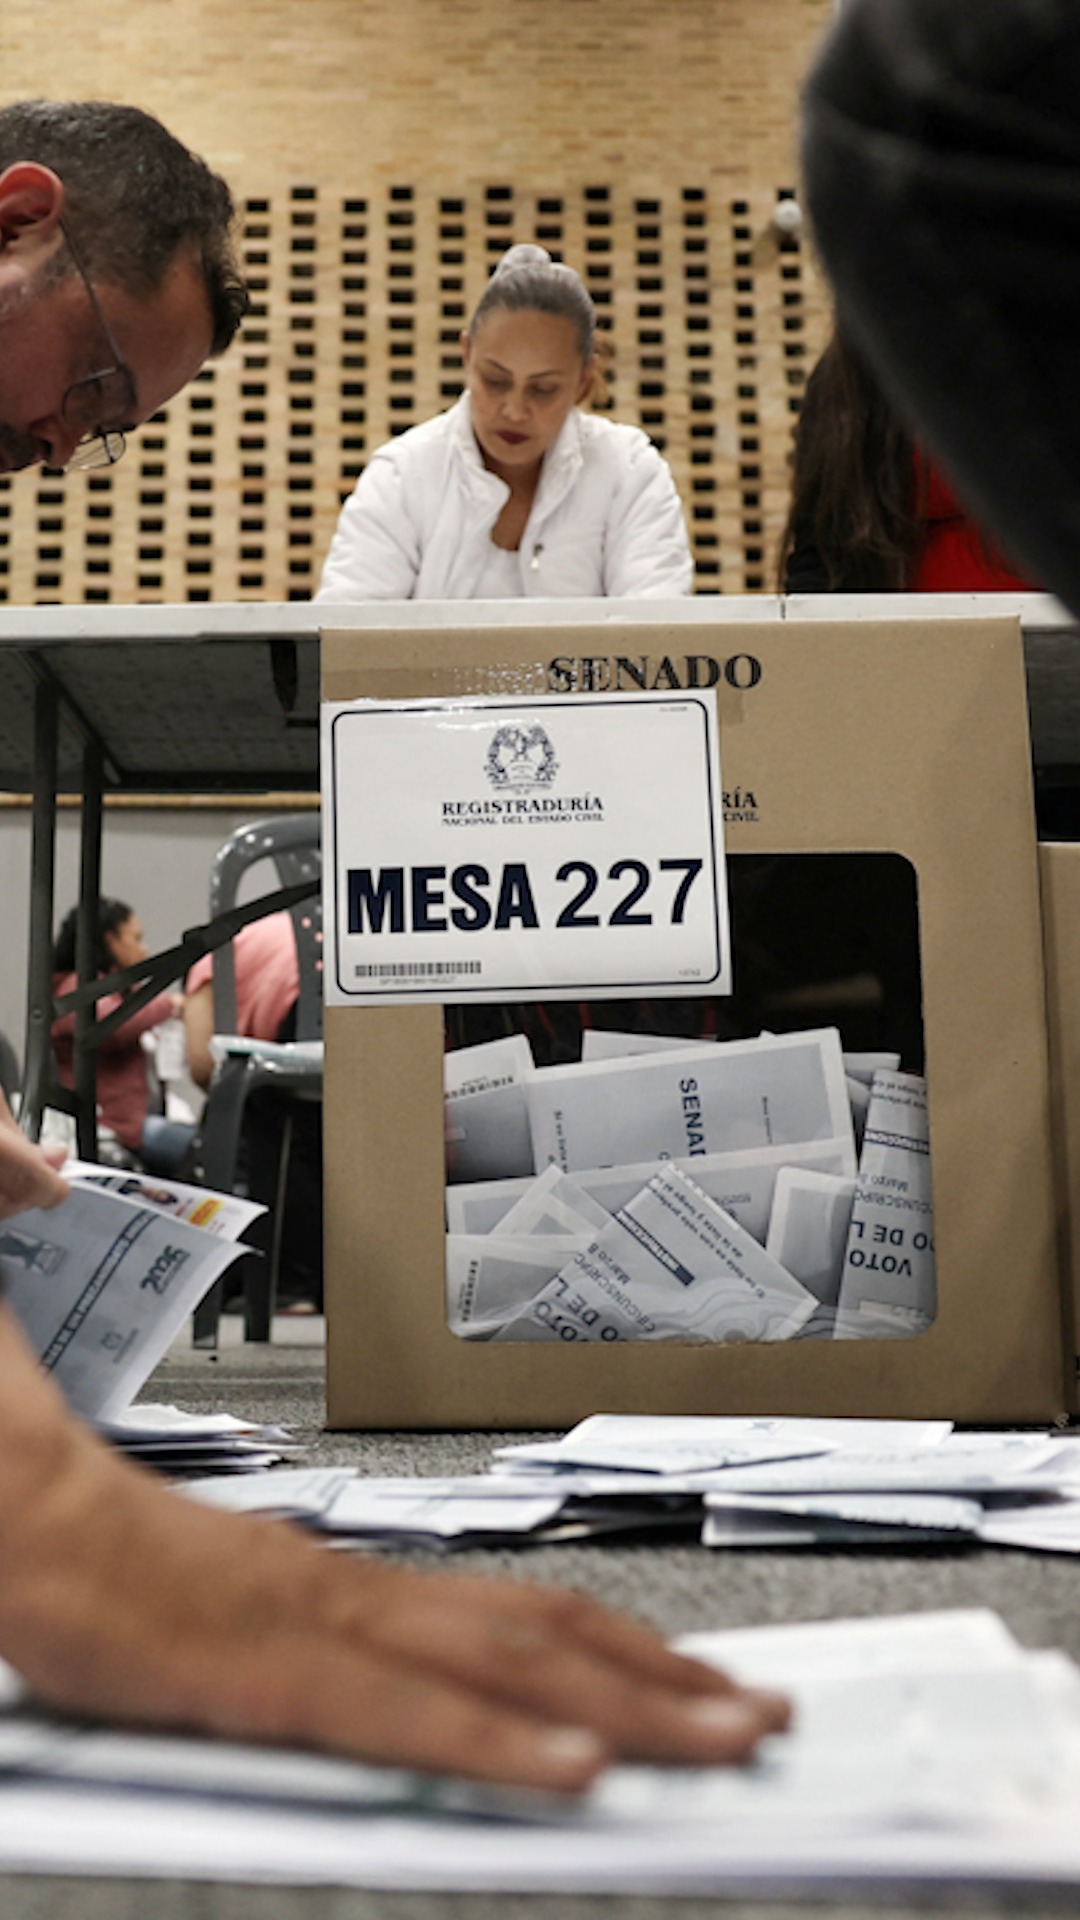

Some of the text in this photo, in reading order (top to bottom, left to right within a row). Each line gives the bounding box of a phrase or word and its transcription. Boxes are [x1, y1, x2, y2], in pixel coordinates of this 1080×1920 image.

[548, 654, 763, 691] SENADO
[442, 792, 604, 816] REGISTRADURÍA
[441, 812, 604, 827] NACIONAL DEL ESTADO CIVIL
[346, 859, 704, 933] MESA 227
[872, 1223, 904, 1246] DE
[849, 1248, 913, 1278] VOTO
[534, 1300, 589, 1342] OTO
